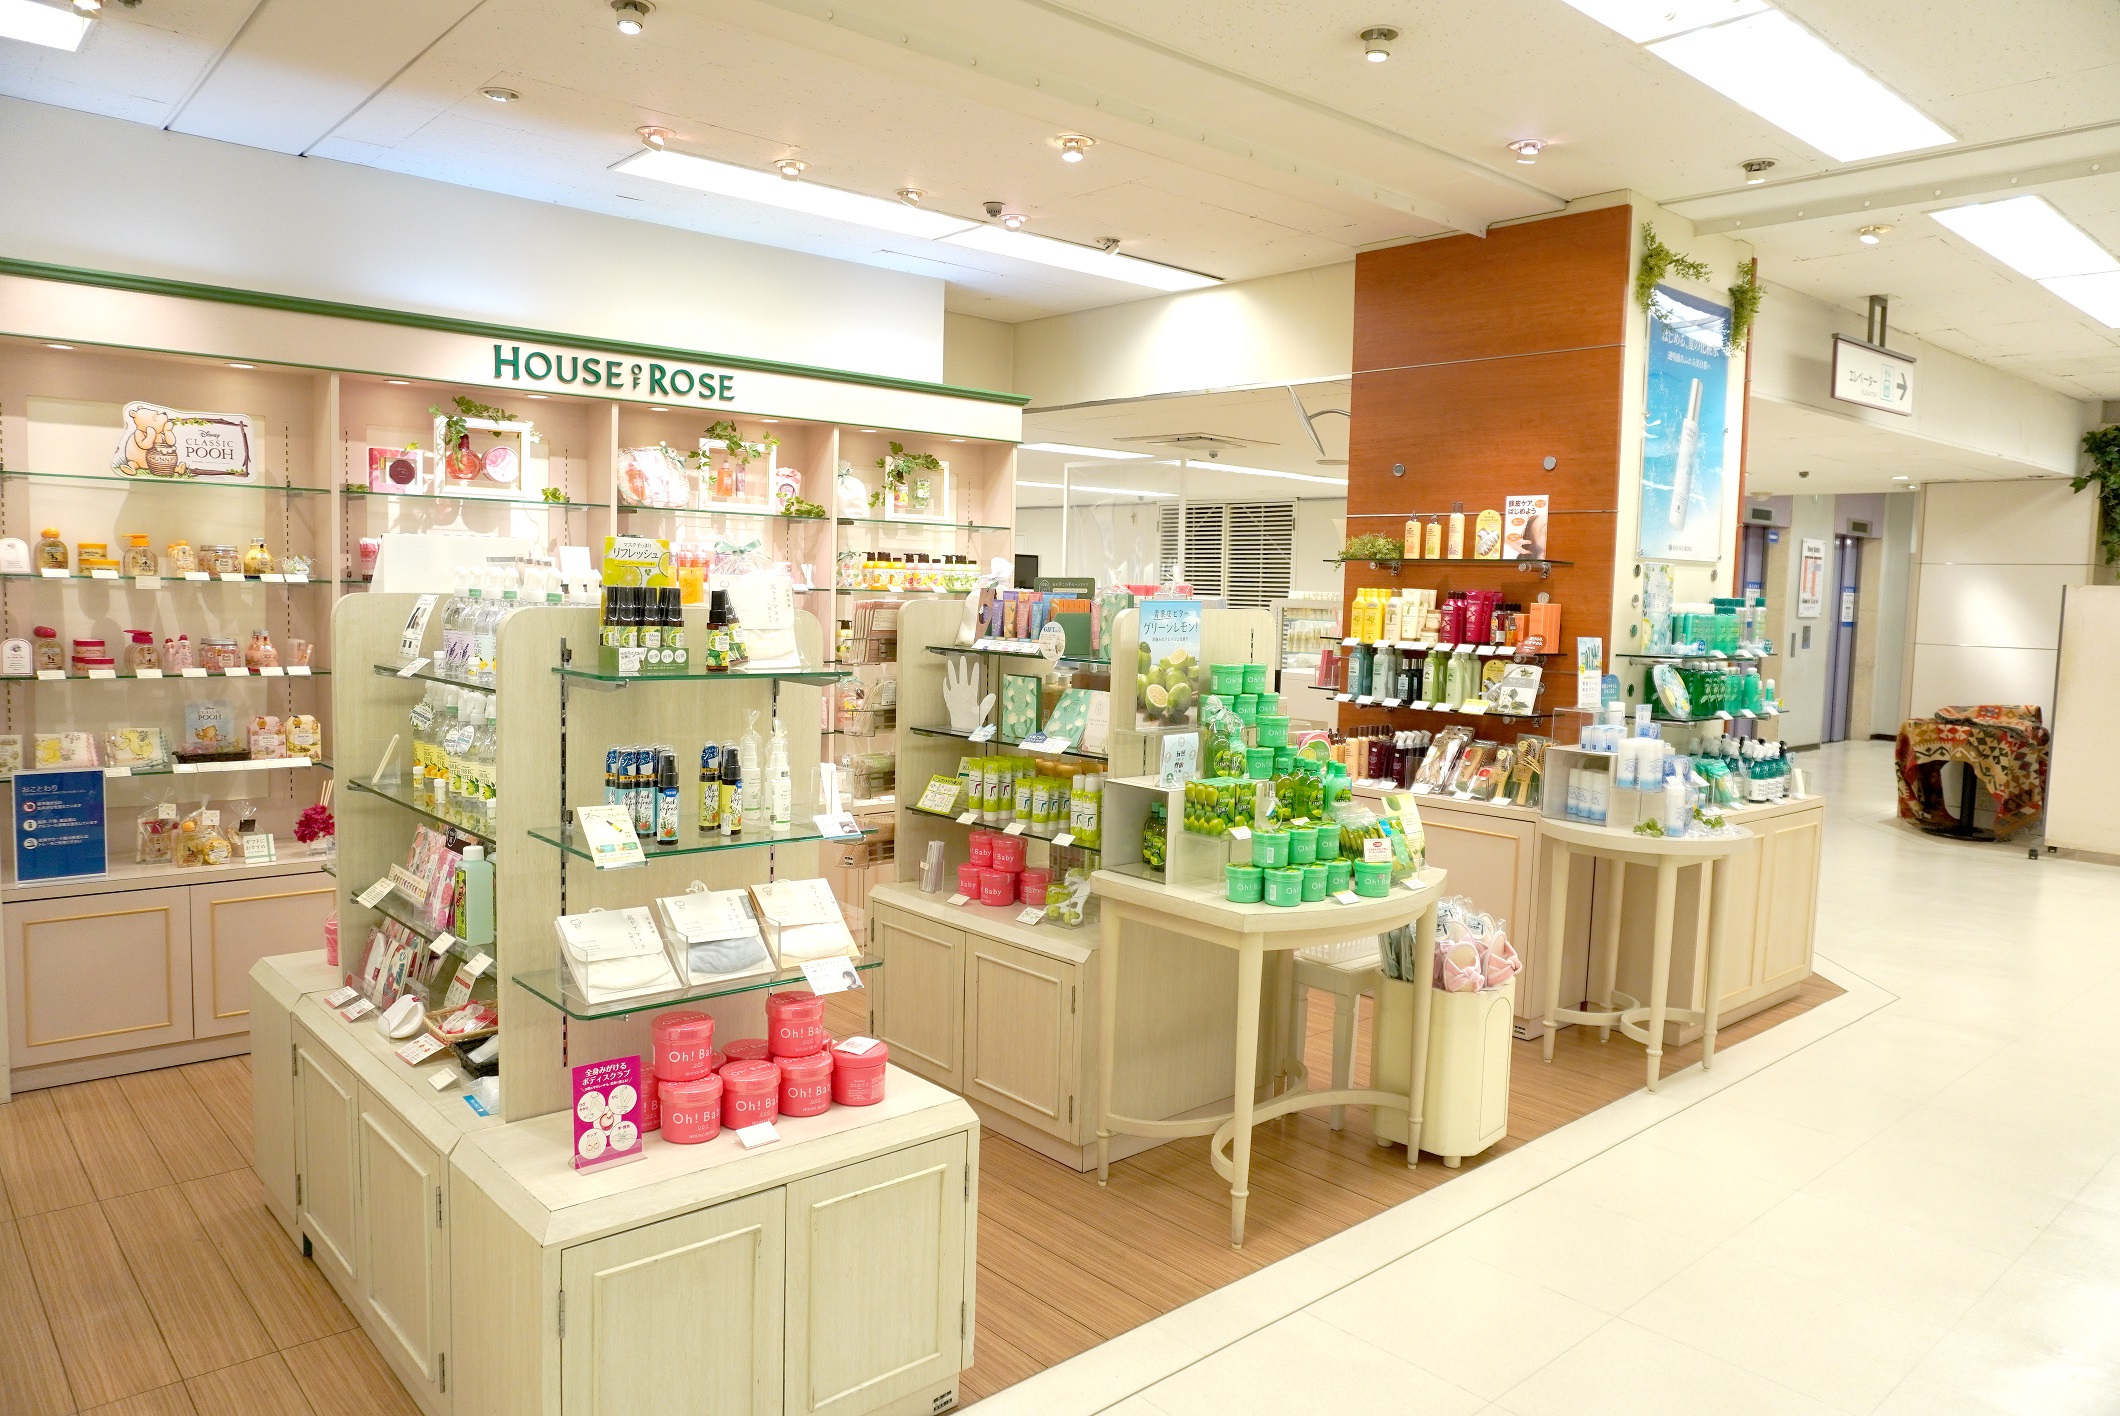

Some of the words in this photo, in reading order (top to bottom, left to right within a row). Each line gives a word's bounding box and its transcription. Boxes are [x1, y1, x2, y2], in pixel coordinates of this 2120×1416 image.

[493, 344, 624, 389] HOUSE
[630, 363, 643, 390] OF
[649, 363, 735, 401] ROSE
[185, 438, 234, 448] CLASSIC
[185, 446, 235, 460] POOH
[613, 547, 659, 559] リフレッシュ
[197, 713, 222, 721] POOH
[22, 784, 58, 793] おことわり
[974, 848, 992, 857] Baby
[997, 853, 1015, 862] Baby
[960, 880, 976, 889] Baby
[984, 887, 1002, 896] Baby
[780, 1027, 804, 1039] Oh!
[668, 1050, 695, 1062] Oh!
[585, 1062, 627, 1077] 全身みがける
[582, 1068, 631, 1086] ボディスクラブ
[788, 1087, 812, 1098] Oh!
[735, 1100, 761, 1112] Oh!
[672, 1112, 698, 1124] Oh!
